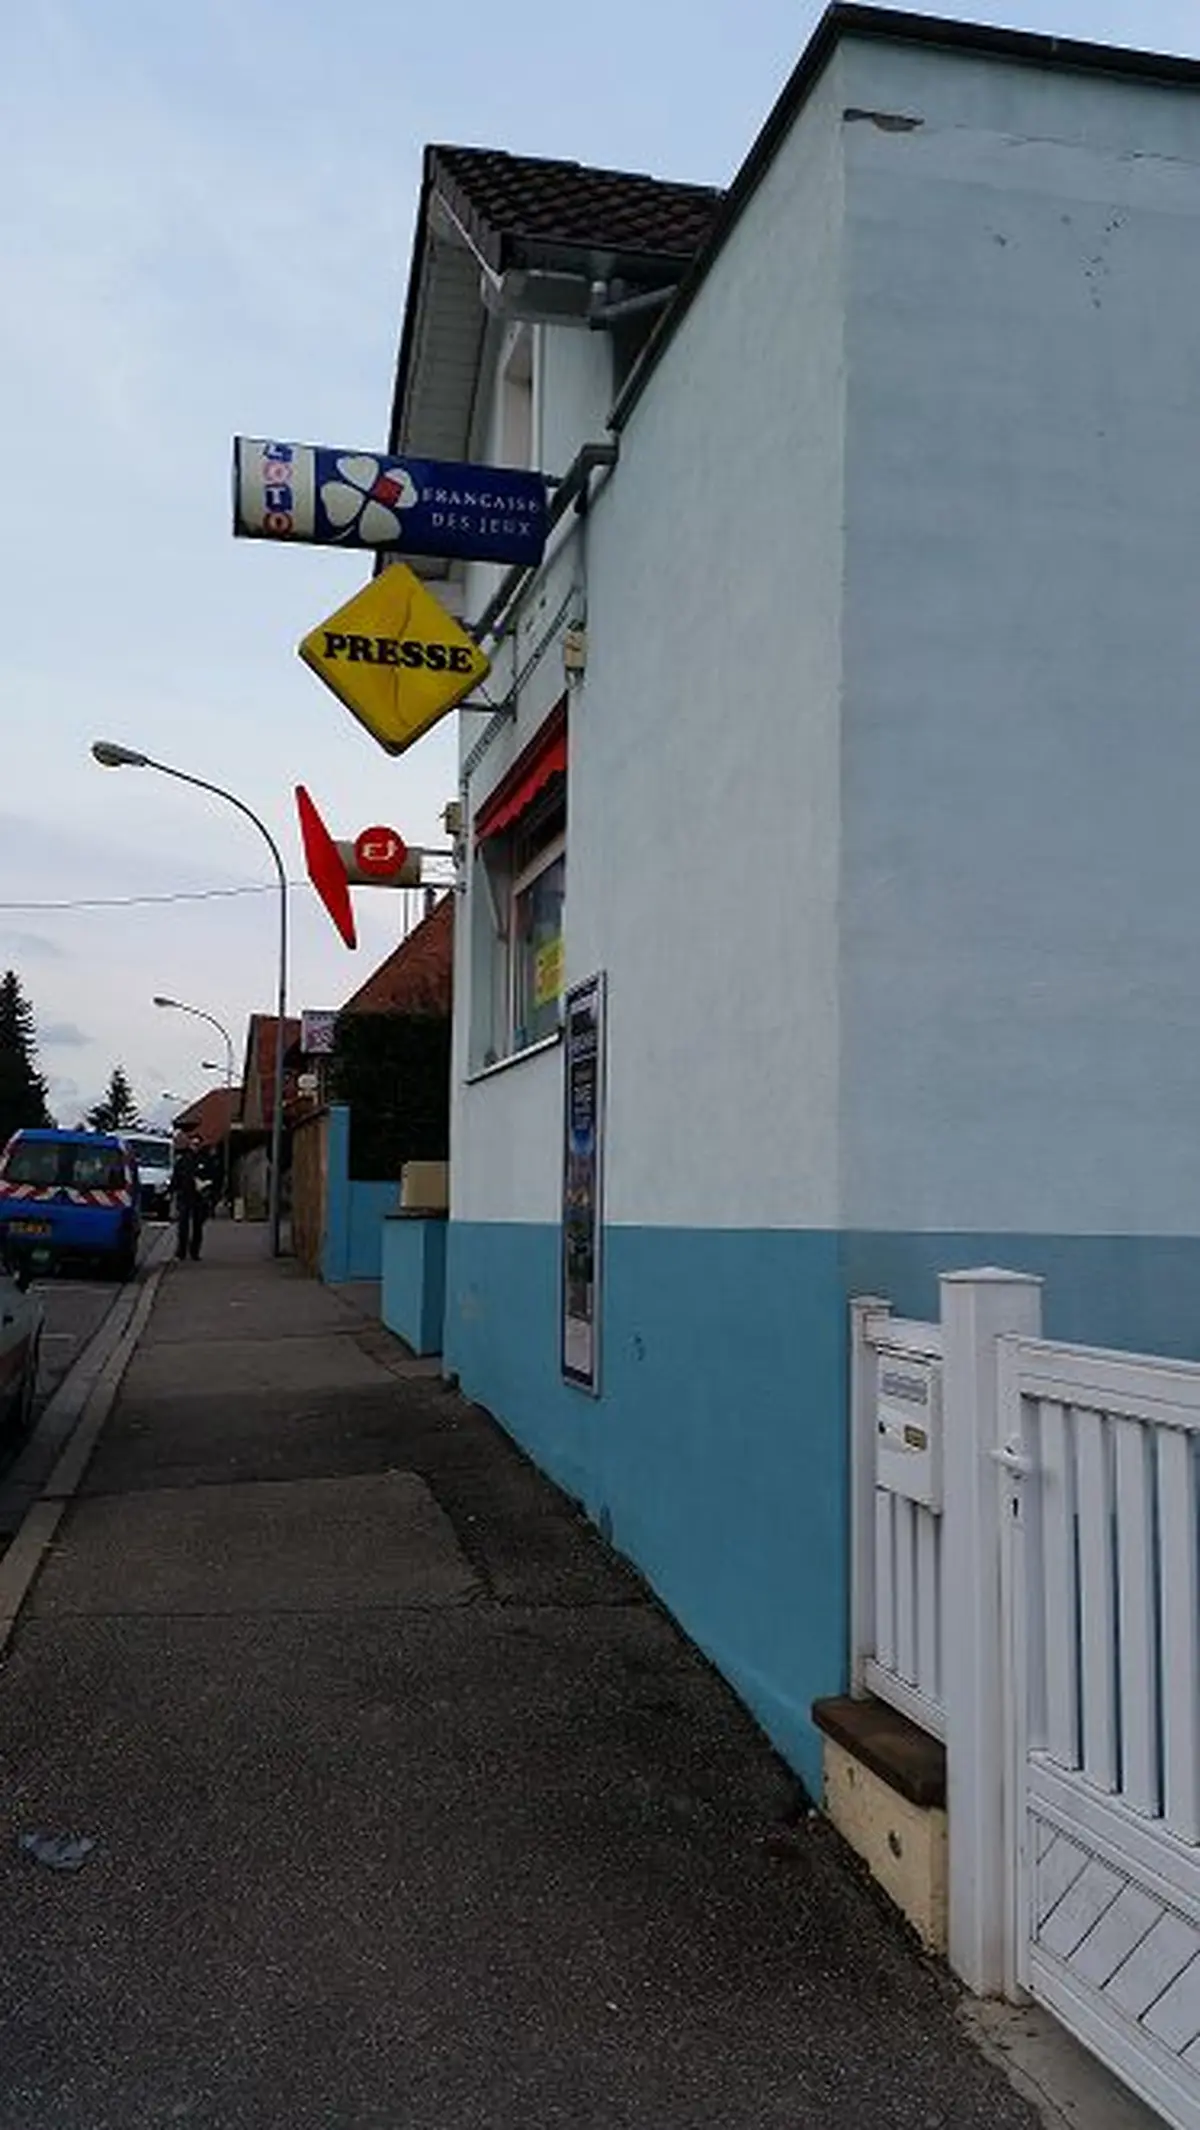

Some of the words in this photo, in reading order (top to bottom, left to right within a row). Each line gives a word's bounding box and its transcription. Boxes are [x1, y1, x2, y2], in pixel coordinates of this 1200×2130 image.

[263, 442, 293, 534] LOTO
[432, 512, 469, 531] DES
[479, 517, 531, 536] JEUX
[323, 632, 473, 673] PRESSE
